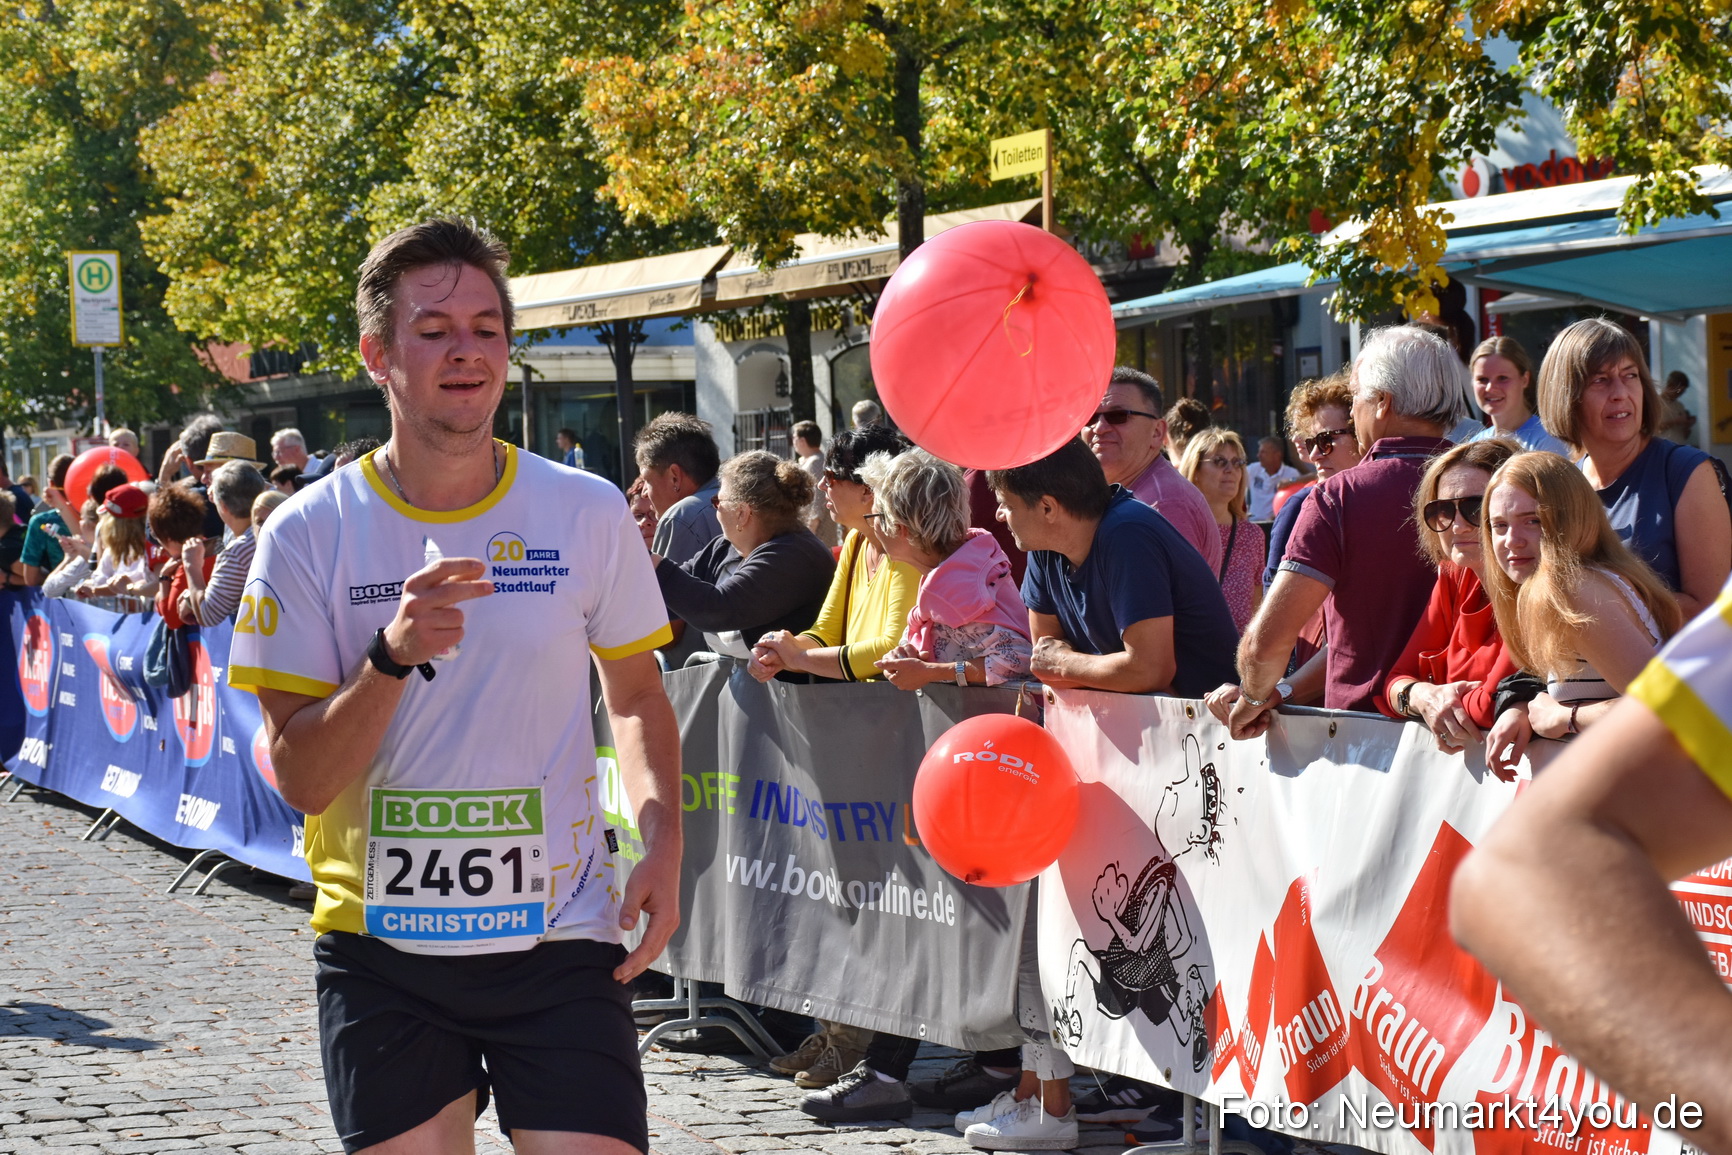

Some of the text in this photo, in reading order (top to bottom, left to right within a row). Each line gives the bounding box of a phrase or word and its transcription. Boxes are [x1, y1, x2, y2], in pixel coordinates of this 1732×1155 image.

[1001, 146, 1043, 166] Toiletten
[1502, 149, 1614, 193] vodao
[491, 540, 557, 562] 20 JAHRE
[492, 564, 570, 577] Neumarkter
[349, 580, 405, 600] BOCK
[493, 580, 557, 595] Stadtlauf
[234, 594, 279, 637] 20
[998, 765, 1038, 785] energie
[682, 772, 741, 815] OFFE
[382, 795, 533, 832] BOCK
[532, 849, 541, 858] D
[385, 846, 523, 897] 2461
[726, 853, 956, 927] w.bockonline.de
[382, 910, 528, 933] CHRISTOPH
[1682, 900, 1732, 931] INDS
[1273, 988, 1342, 1077] Braun
[1350, 954, 1446, 1096] Braun
[1306, 1050, 1331, 1073] Sicher
[1378, 1053, 1410, 1100] Sicher ist
[1533, 1120, 1583, 1153] Sicher
[1587, 1133, 1607, 1155] ist
